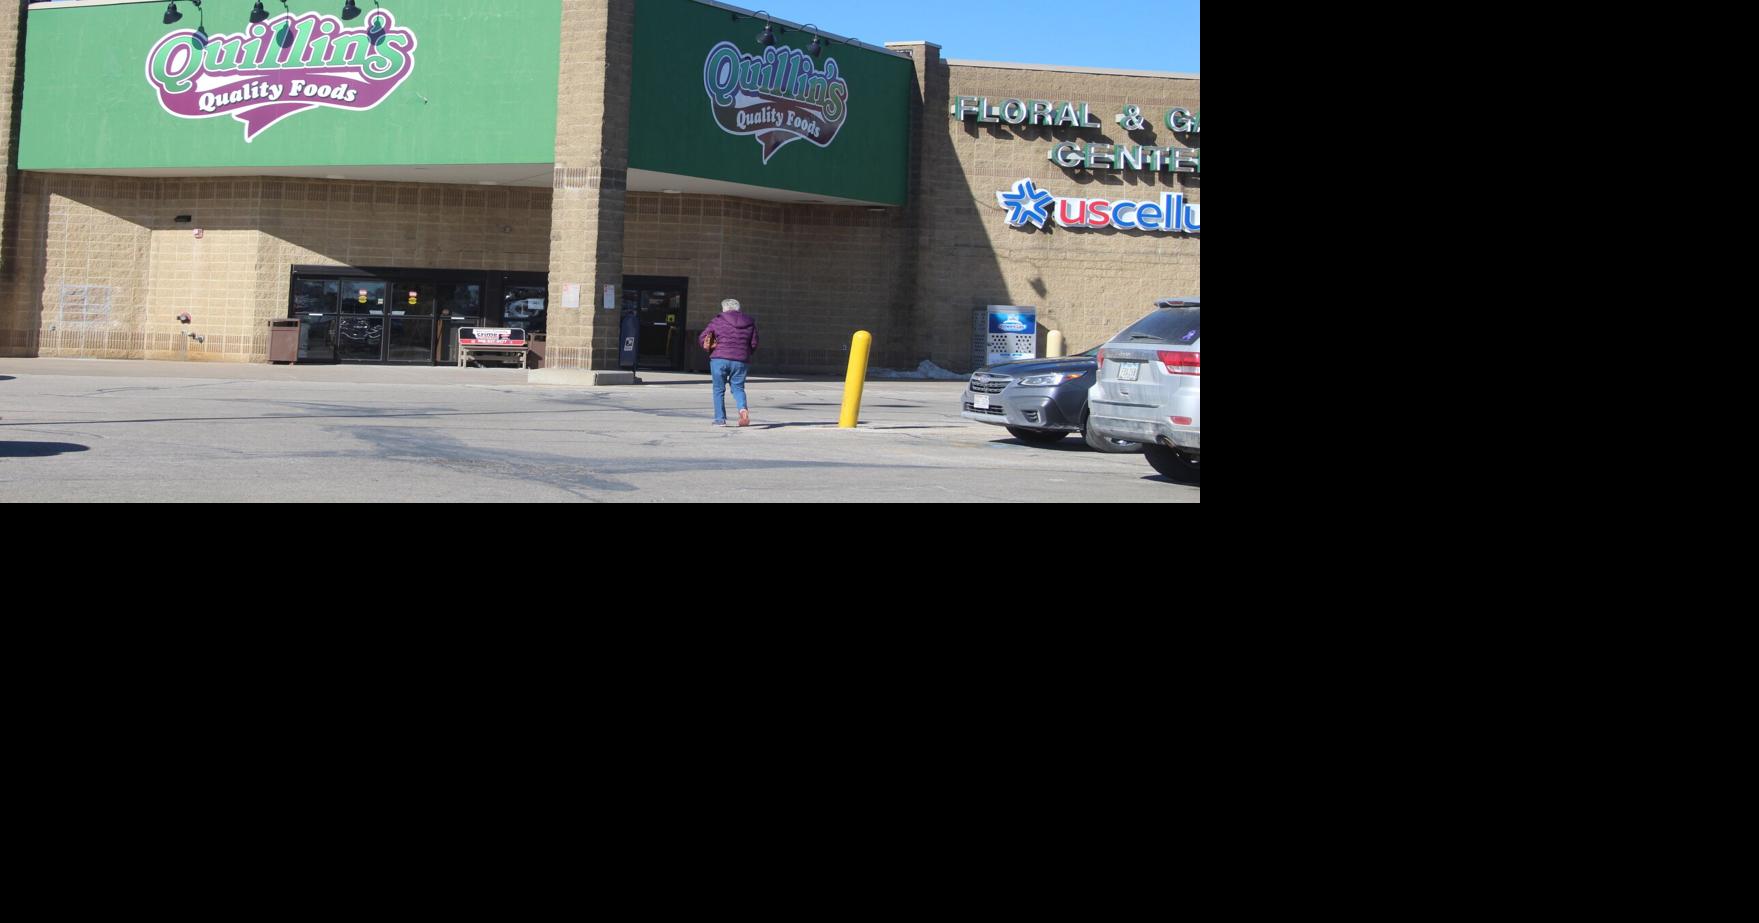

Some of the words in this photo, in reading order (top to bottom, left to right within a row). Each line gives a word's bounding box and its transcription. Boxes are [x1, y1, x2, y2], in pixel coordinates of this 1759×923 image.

[198, 80, 283, 112] Quality
[288, 79, 357, 102] Foods
[708, 47, 845, 122] Quillin's
[736, 106, 784, 130] Quality
[786, 110, 821, 138] Foods
[955, 95, 1100, 128] FLORAL
[1120, 104, 1145, 131] &
[1051, 141, 1200, 173] CENTE
